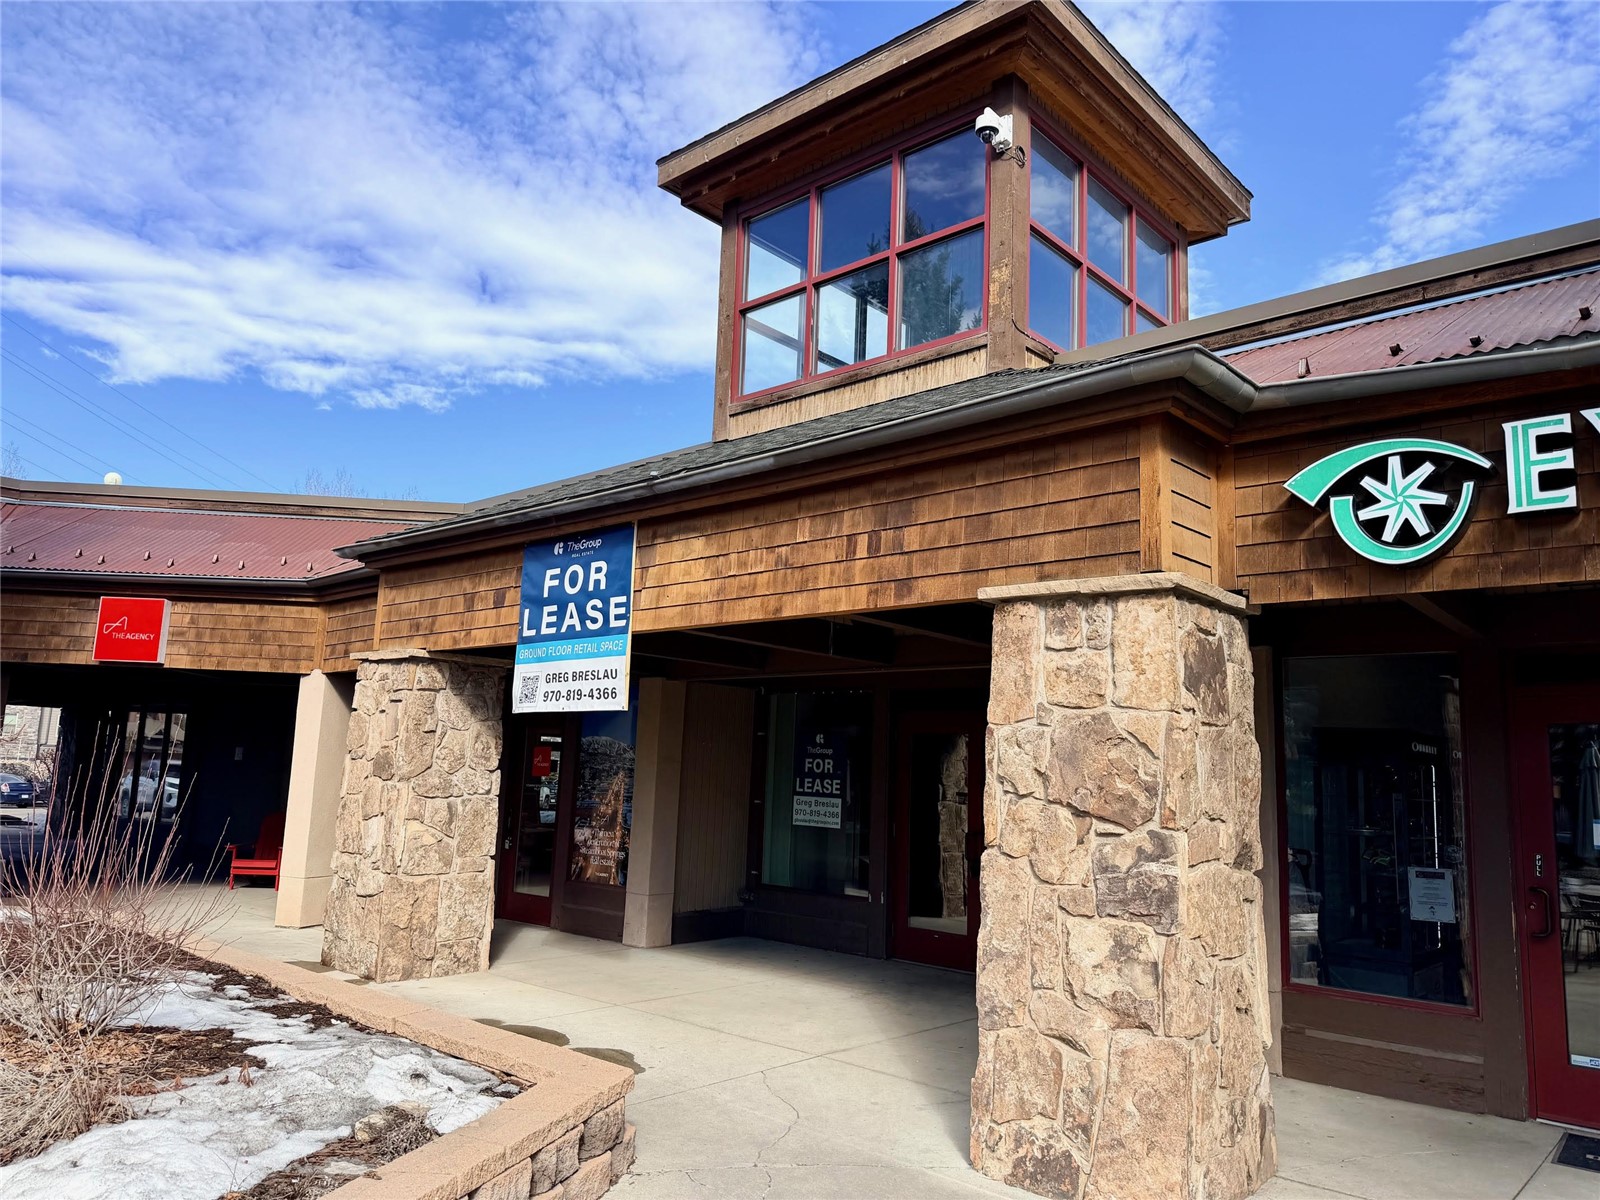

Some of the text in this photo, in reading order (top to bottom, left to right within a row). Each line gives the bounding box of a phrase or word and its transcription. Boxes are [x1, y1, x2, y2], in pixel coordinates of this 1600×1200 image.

[1501, 407, 1600, 514] E
[543, 560, 608, 598] FOR
[522, 595, 627, 637] LEASE
[519, 639, 624, 659] GROUND FLOOR RETAIL SPACE
[545, 668, 618, 684] GREG BRESLAU
[543, 687, 618, 702] 970-819-4366
[805, 758, 834, 773] FOR
[796, 777, 841, 794] LEASE
[796, 799, 839, 809] Greg Breslau
[794, 808, 840, 819] 970-819-4366
